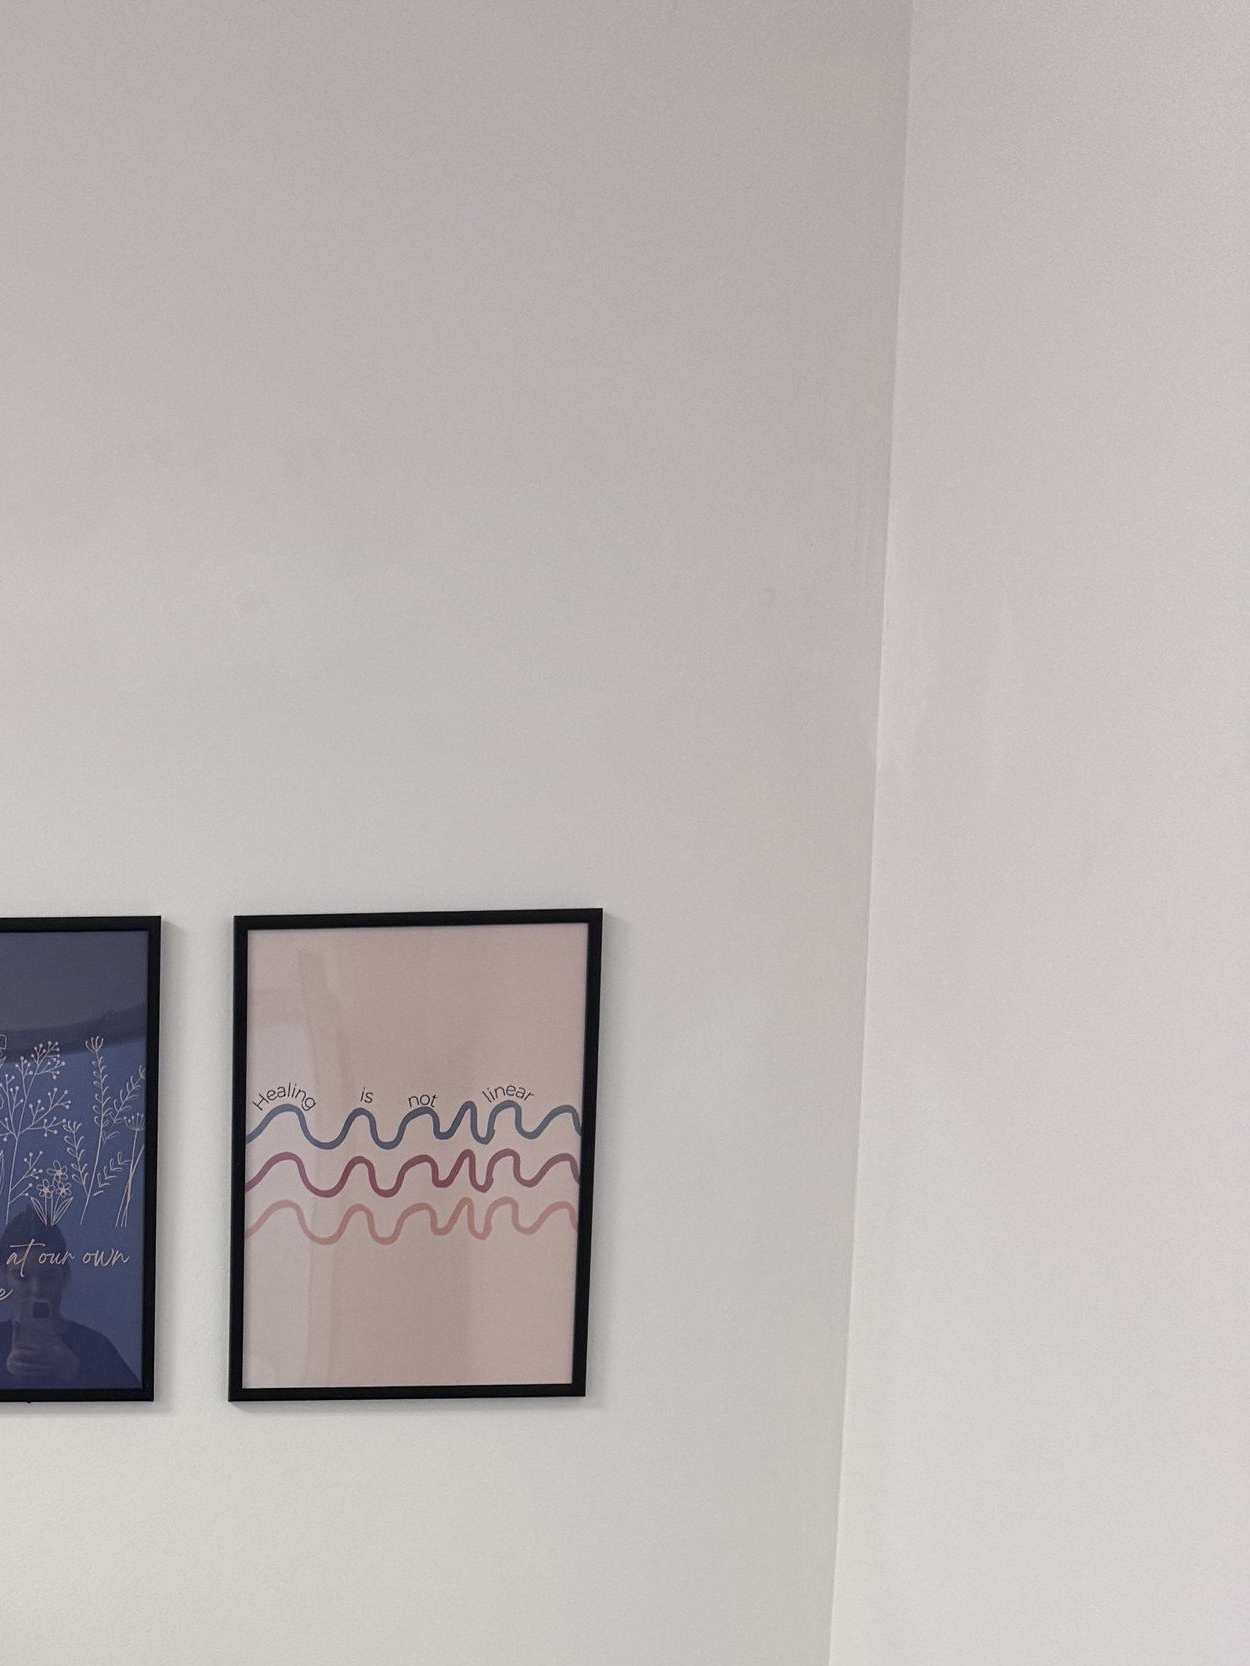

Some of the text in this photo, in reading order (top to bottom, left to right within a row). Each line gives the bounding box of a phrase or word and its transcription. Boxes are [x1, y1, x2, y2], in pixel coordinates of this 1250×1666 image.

[252, 1082, 535, 1112] Healing is not linear
[6, 1238, 46, 1277] at
[38, 1248, 75, 1265] our
[82, 1248, 130, 1265] own
